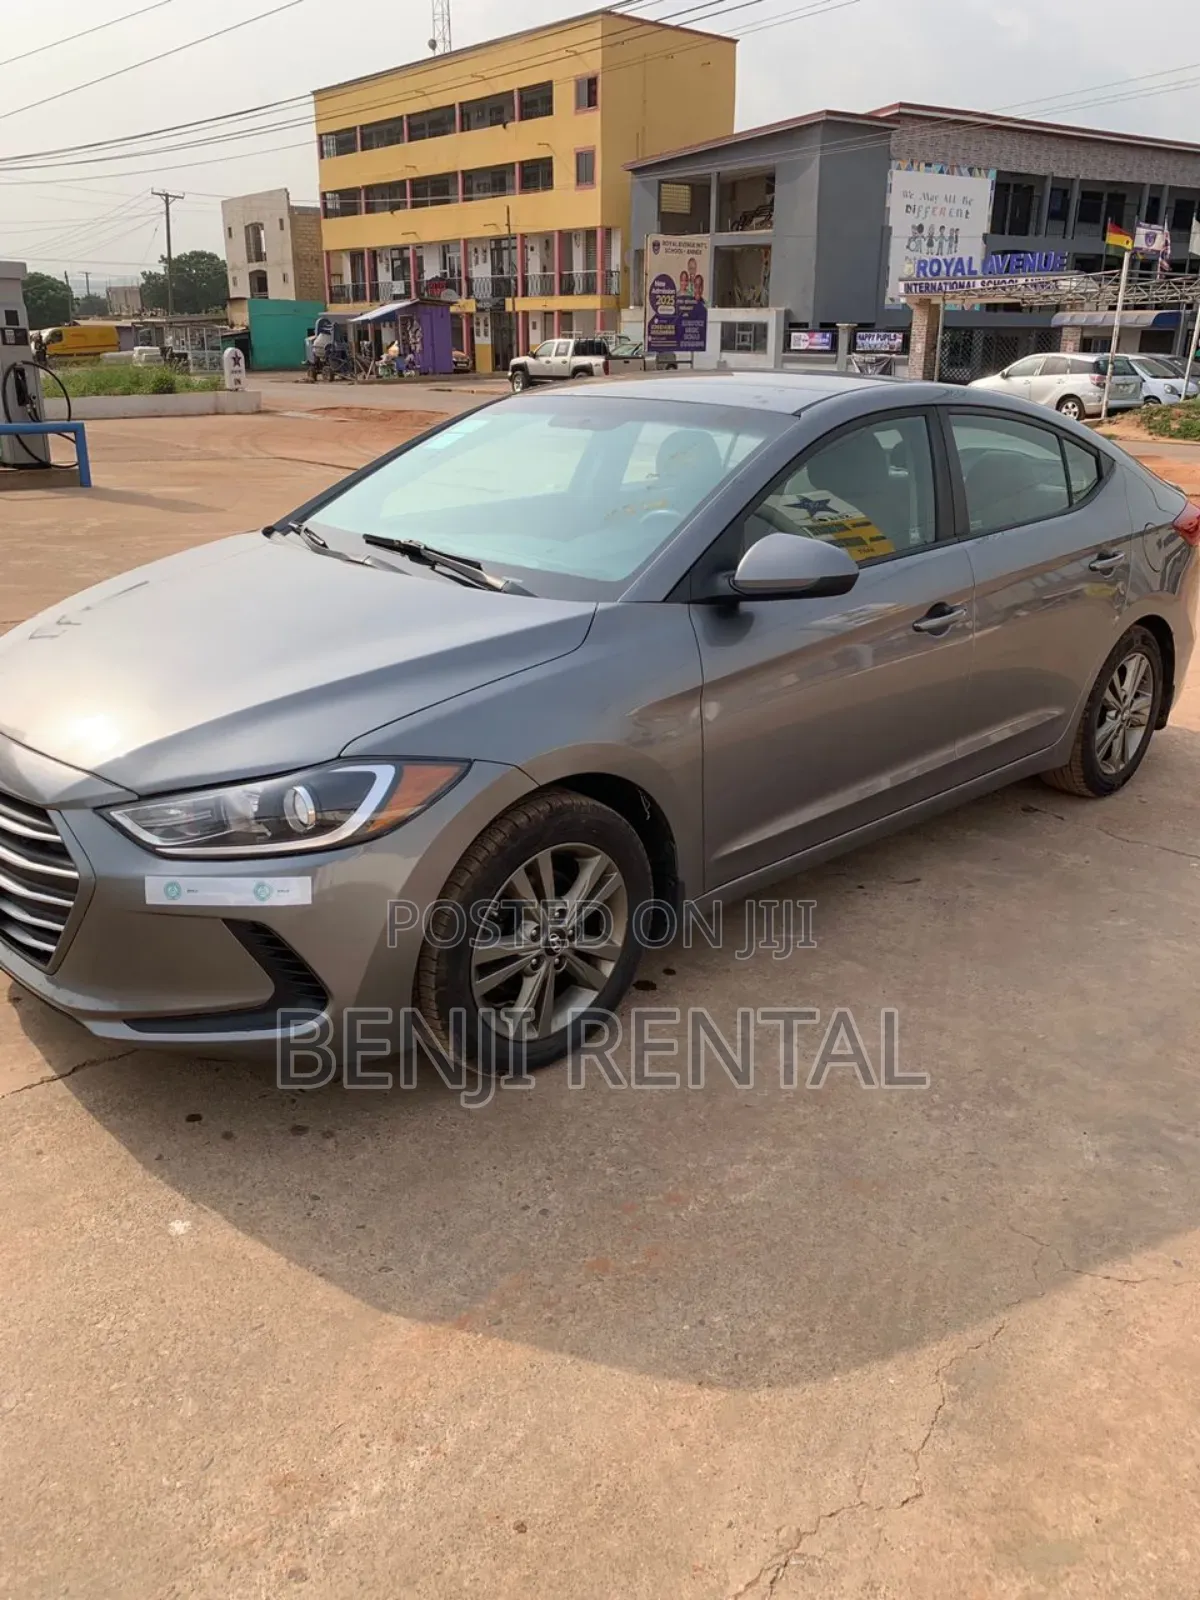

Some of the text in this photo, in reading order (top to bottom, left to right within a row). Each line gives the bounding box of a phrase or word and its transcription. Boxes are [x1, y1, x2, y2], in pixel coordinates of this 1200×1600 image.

[916, 256, 977, 277] ROYAL
[981, 252, 1067, 275] AVENUE
[903, 280, 977, 295] INTERNATIONAL
